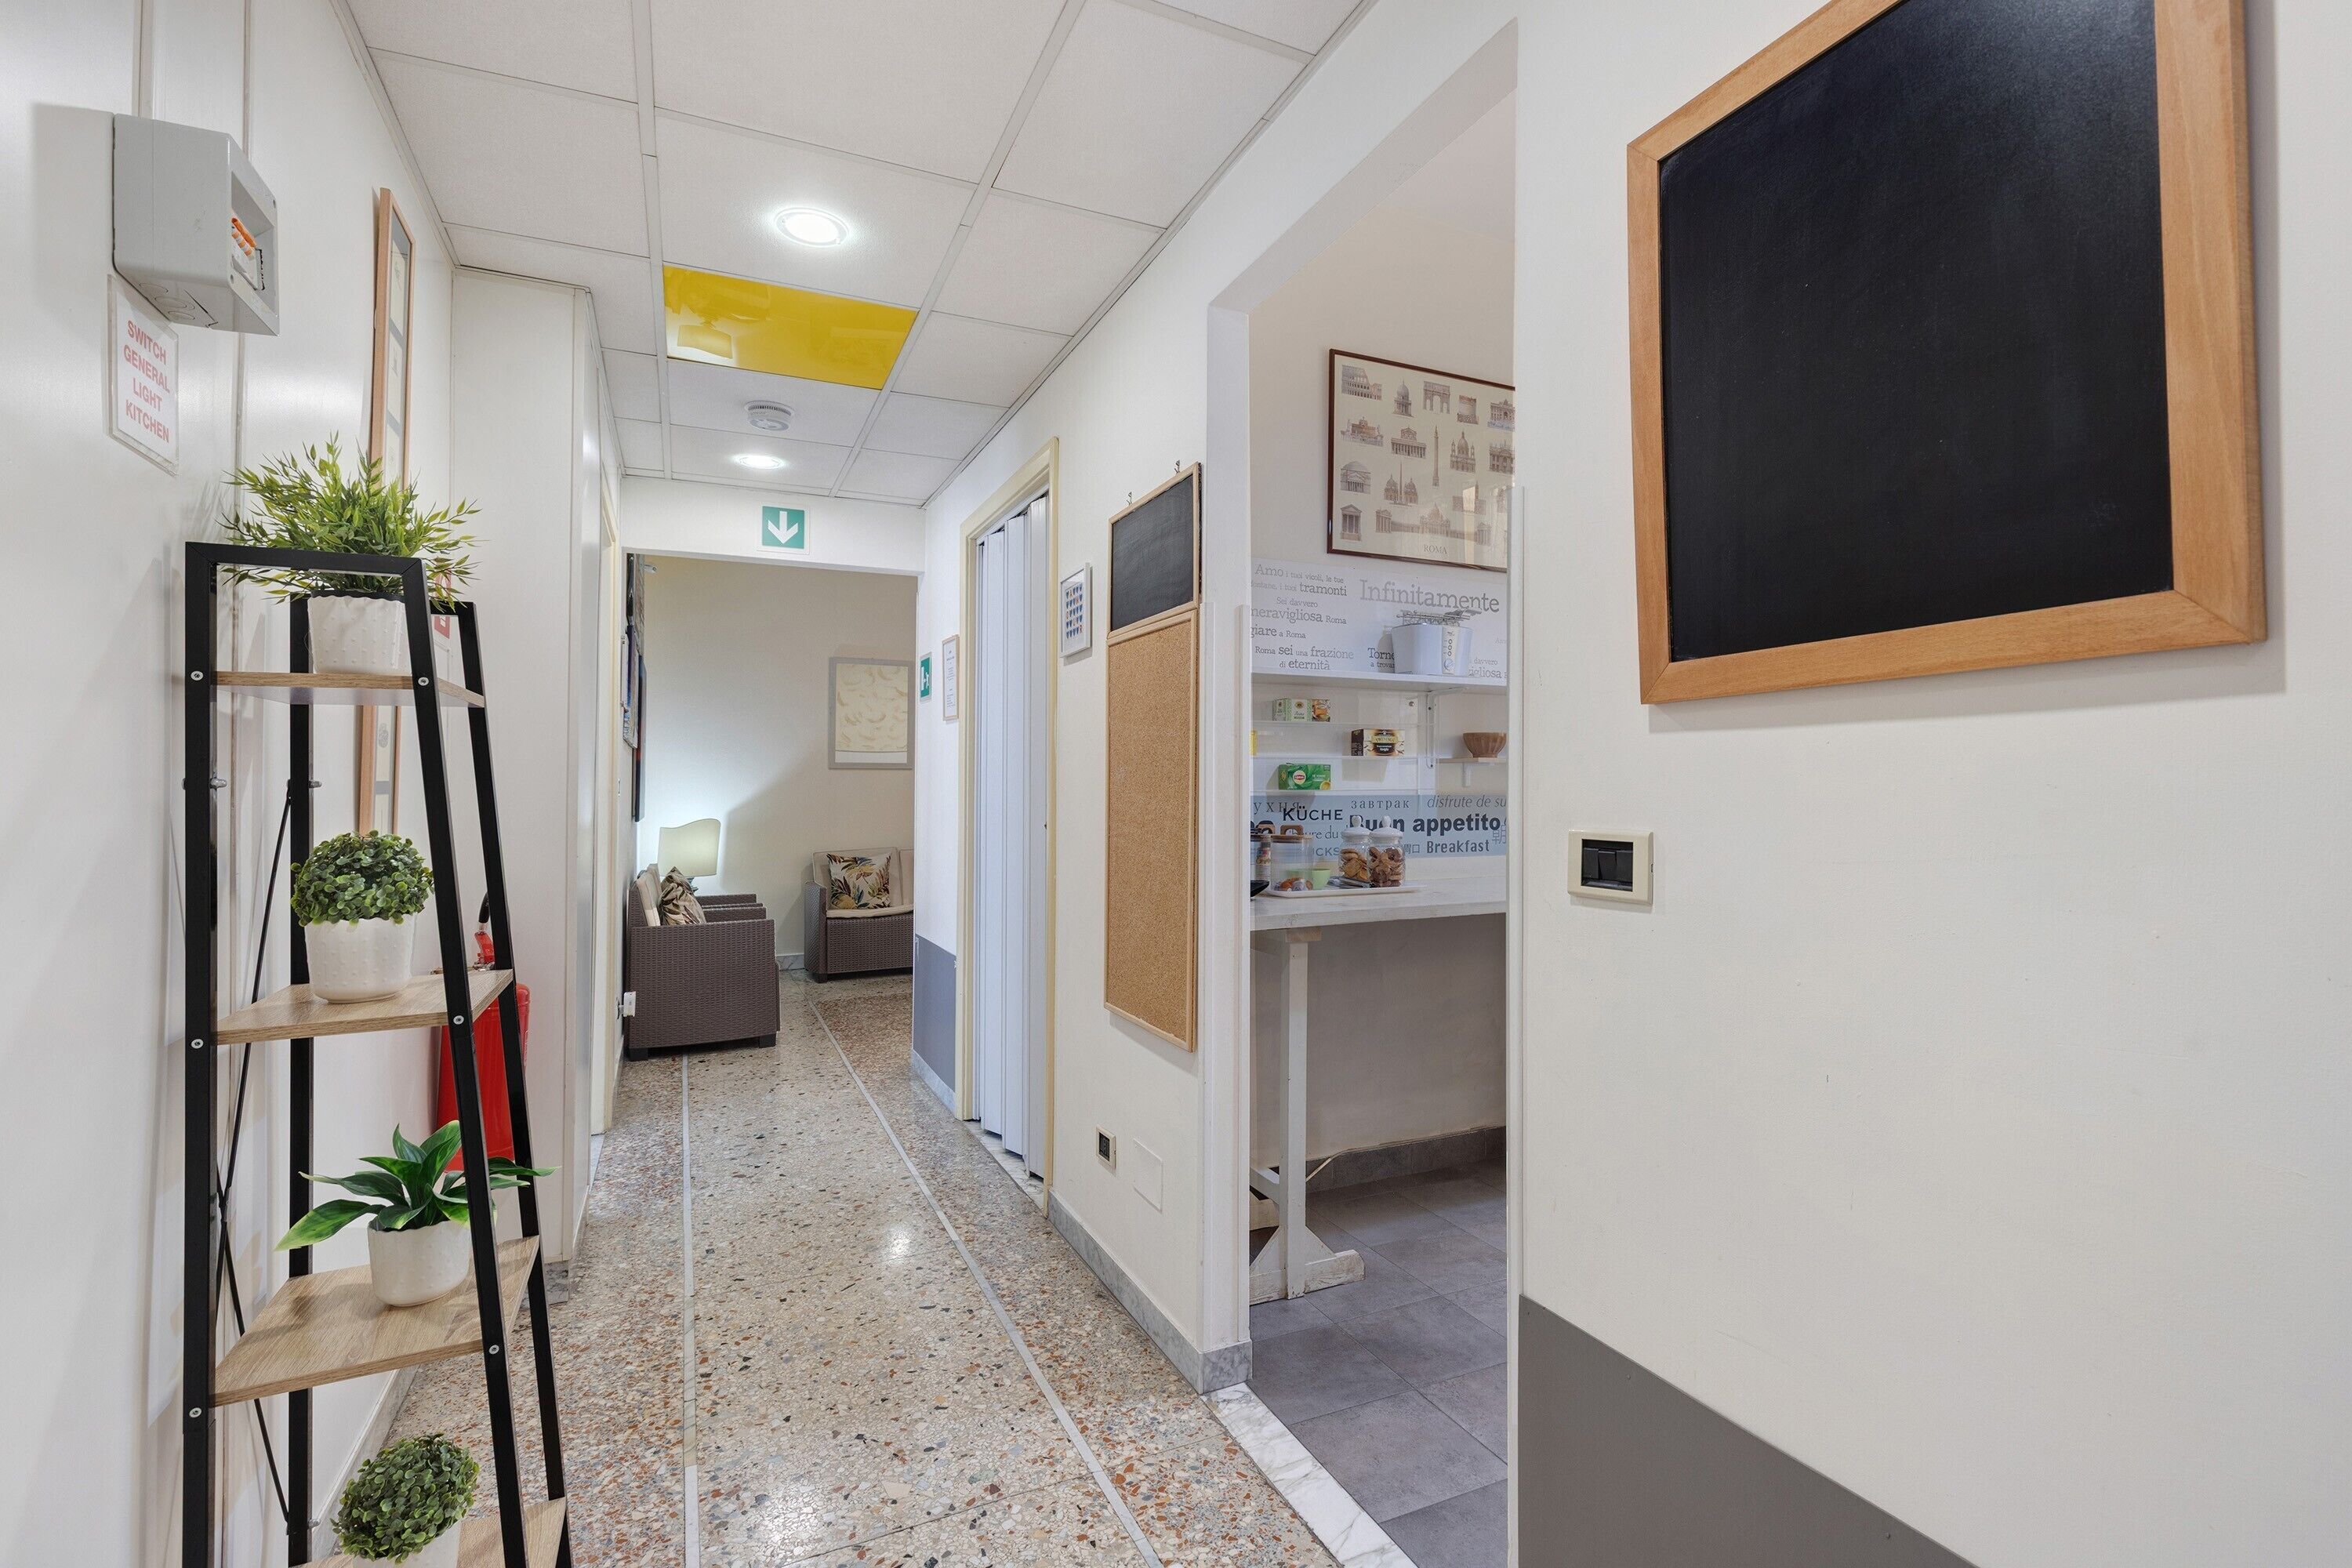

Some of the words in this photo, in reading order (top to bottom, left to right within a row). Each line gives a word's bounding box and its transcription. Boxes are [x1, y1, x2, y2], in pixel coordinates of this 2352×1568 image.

[127, 320, 167, 365] SWITCH
[123, 344, 170, 393] GENERAL
[132, 377, 162, 412] LIGHT
[125, 399, 169, 444] KITCHEN
[1424, 544, 1447, 554] ROMA
[1254, 564, 1283, 577] Amo
[1300, 582, 1347, 597] tramonti
[1359, 579, 1500, 613] Infinitamente
[1276, 597, 1287, 605] Sei
[1290, 598, 1318, 608] davvero
[1326, 615, 1347, 625] Roma
[1255, 645, 1276, 655] Roma
[1278, 644, 1293, 655] sei
[1310, 645, 1354, 659] frazione
[1288, 659, 1330, 670] eternità
[1351, 799, 1410, 810] завтрак
[1427, 795, 1473, 808] disfrute
[1476, 795, 1490, 808] de
[1283, 805, 1343, 821] KÜCHE
[1324, 825, 1338, 839] du
[1413, 813, 1501, 837] appetito
[1427, 840, 1490, 854] Breakfast
